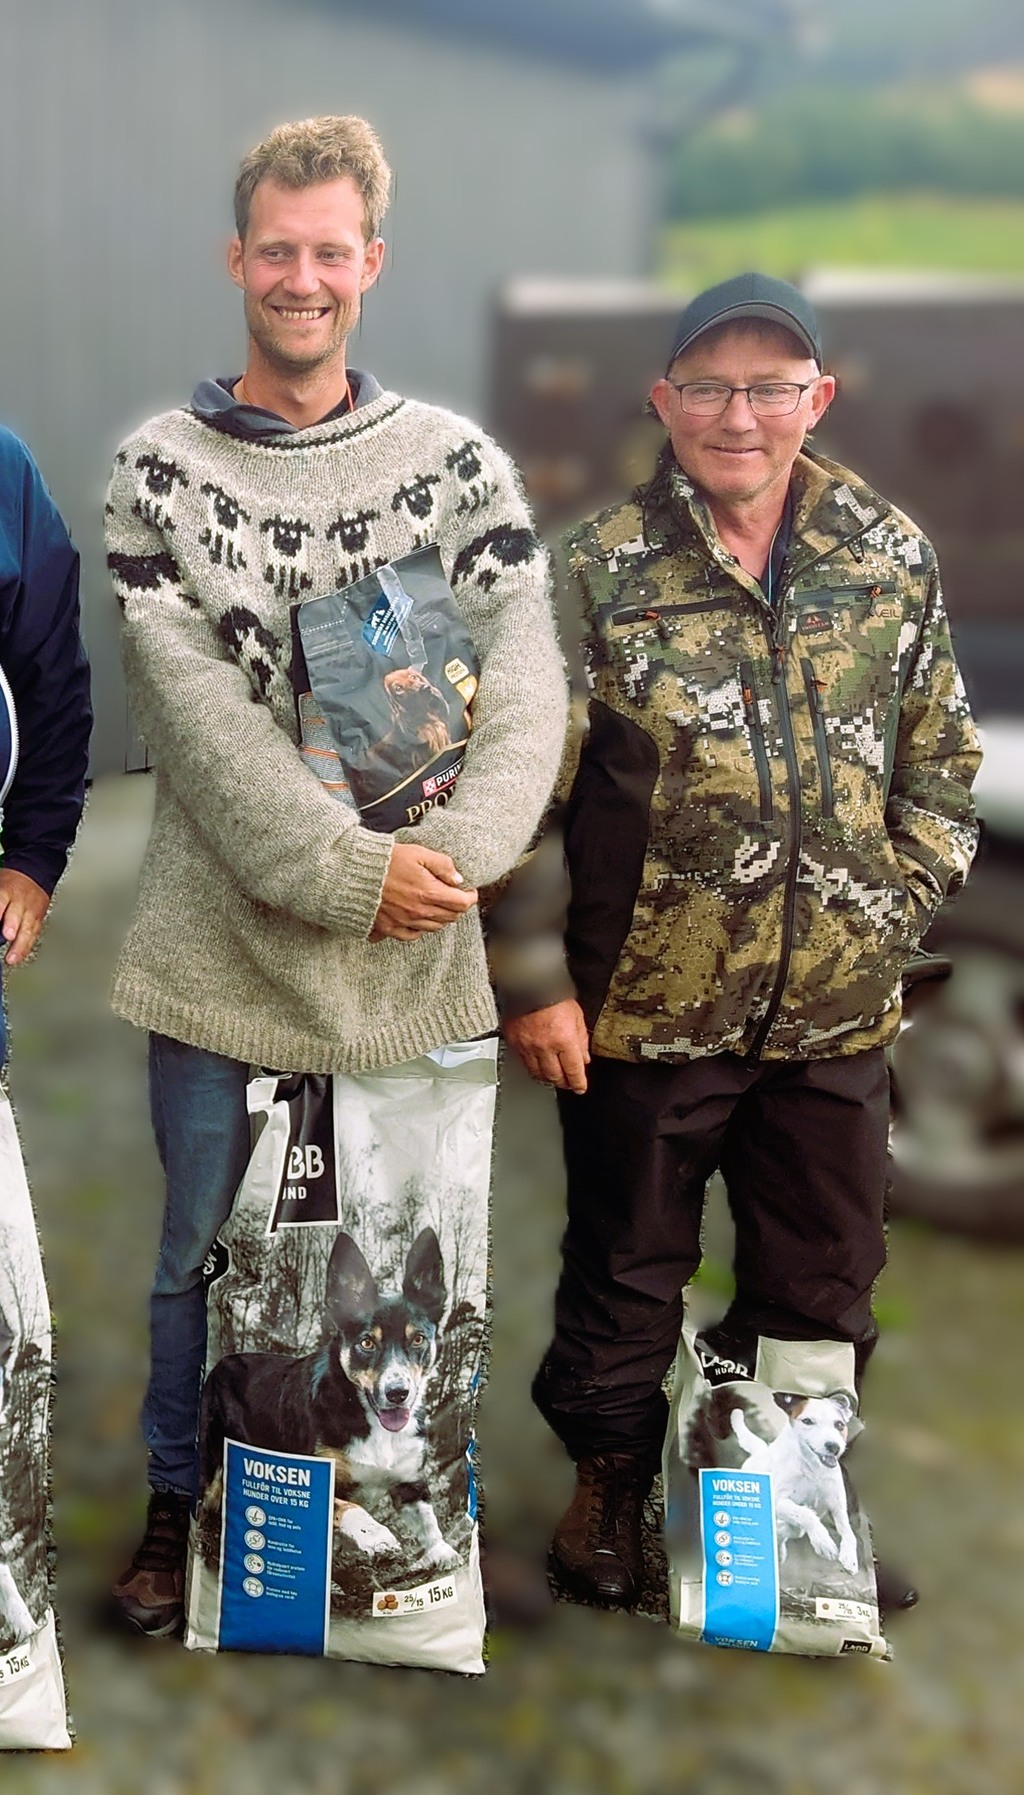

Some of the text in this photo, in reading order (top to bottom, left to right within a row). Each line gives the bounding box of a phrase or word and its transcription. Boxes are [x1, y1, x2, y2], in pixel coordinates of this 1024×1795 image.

[436, 761, 464, 786] PURI
[287, 1144, 325, 1180] BB
[282, 1186, 307, 1200] ND
[243, 1458, 311, 1487] VOKSEN
[271, 1485, 282, 1495] TIL
[284, 1488, 311, 1499] VOKSNE
[712, 1479, 760, 1494] VOKSEN
[243, 1488, 309, 1508] HUNDER OVER 15 KG
[428, 1586, 441, 1603] 15
[442, 1586, 453, 1599] KG
[715, 1636, 758, 1647] VOKSEN
[5, 1656, 21, 1675] 15
[20, 1655, 30, 1670] KG
